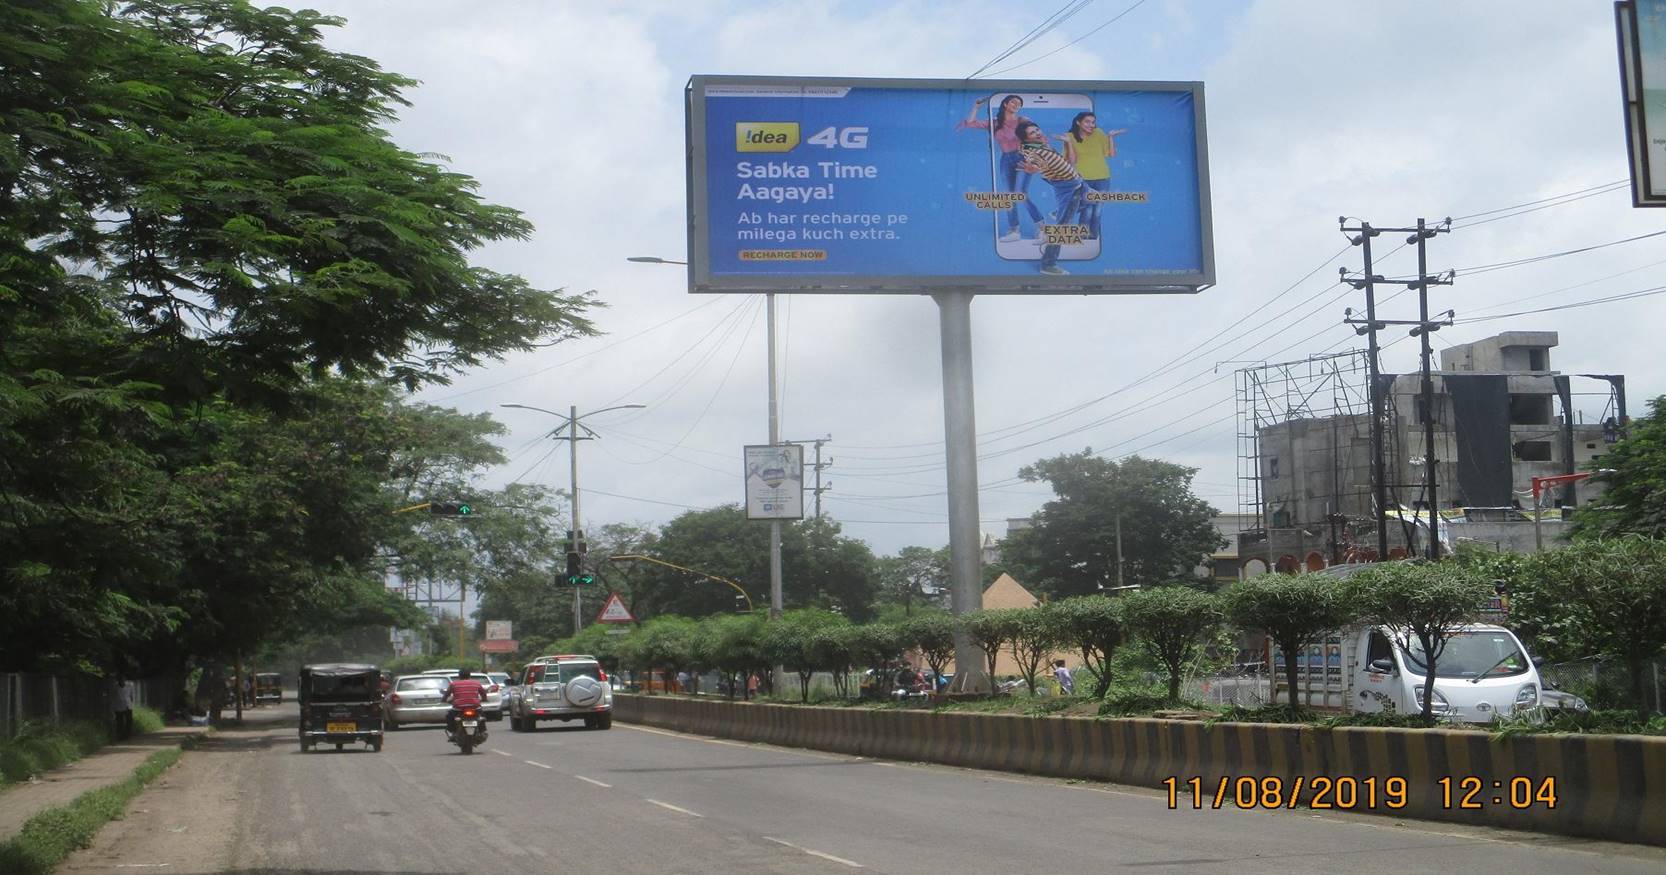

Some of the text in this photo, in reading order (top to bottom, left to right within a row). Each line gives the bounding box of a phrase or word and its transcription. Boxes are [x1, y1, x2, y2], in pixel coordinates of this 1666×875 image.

[807, 126, 869, 149] 4G
[737, 162, 878, 178] Sabka Time
[737, 183, 834, 203] Aagaya!
[965, 193, 1025, 201] UNLIMITED
[1086, 193, 1146, 201] CASHBACK
[976, 201, 1012, 209] CALLS
[737, 212, 909, 227] Ab har recharge pe
[1044, 226, 1089, 235] EXTRA
[737, 228, 901, 243] milega kuch extra.
[1048, 236, 1083, 244] DATA
[743, 251, 824, 259] RECHARGE NOW
